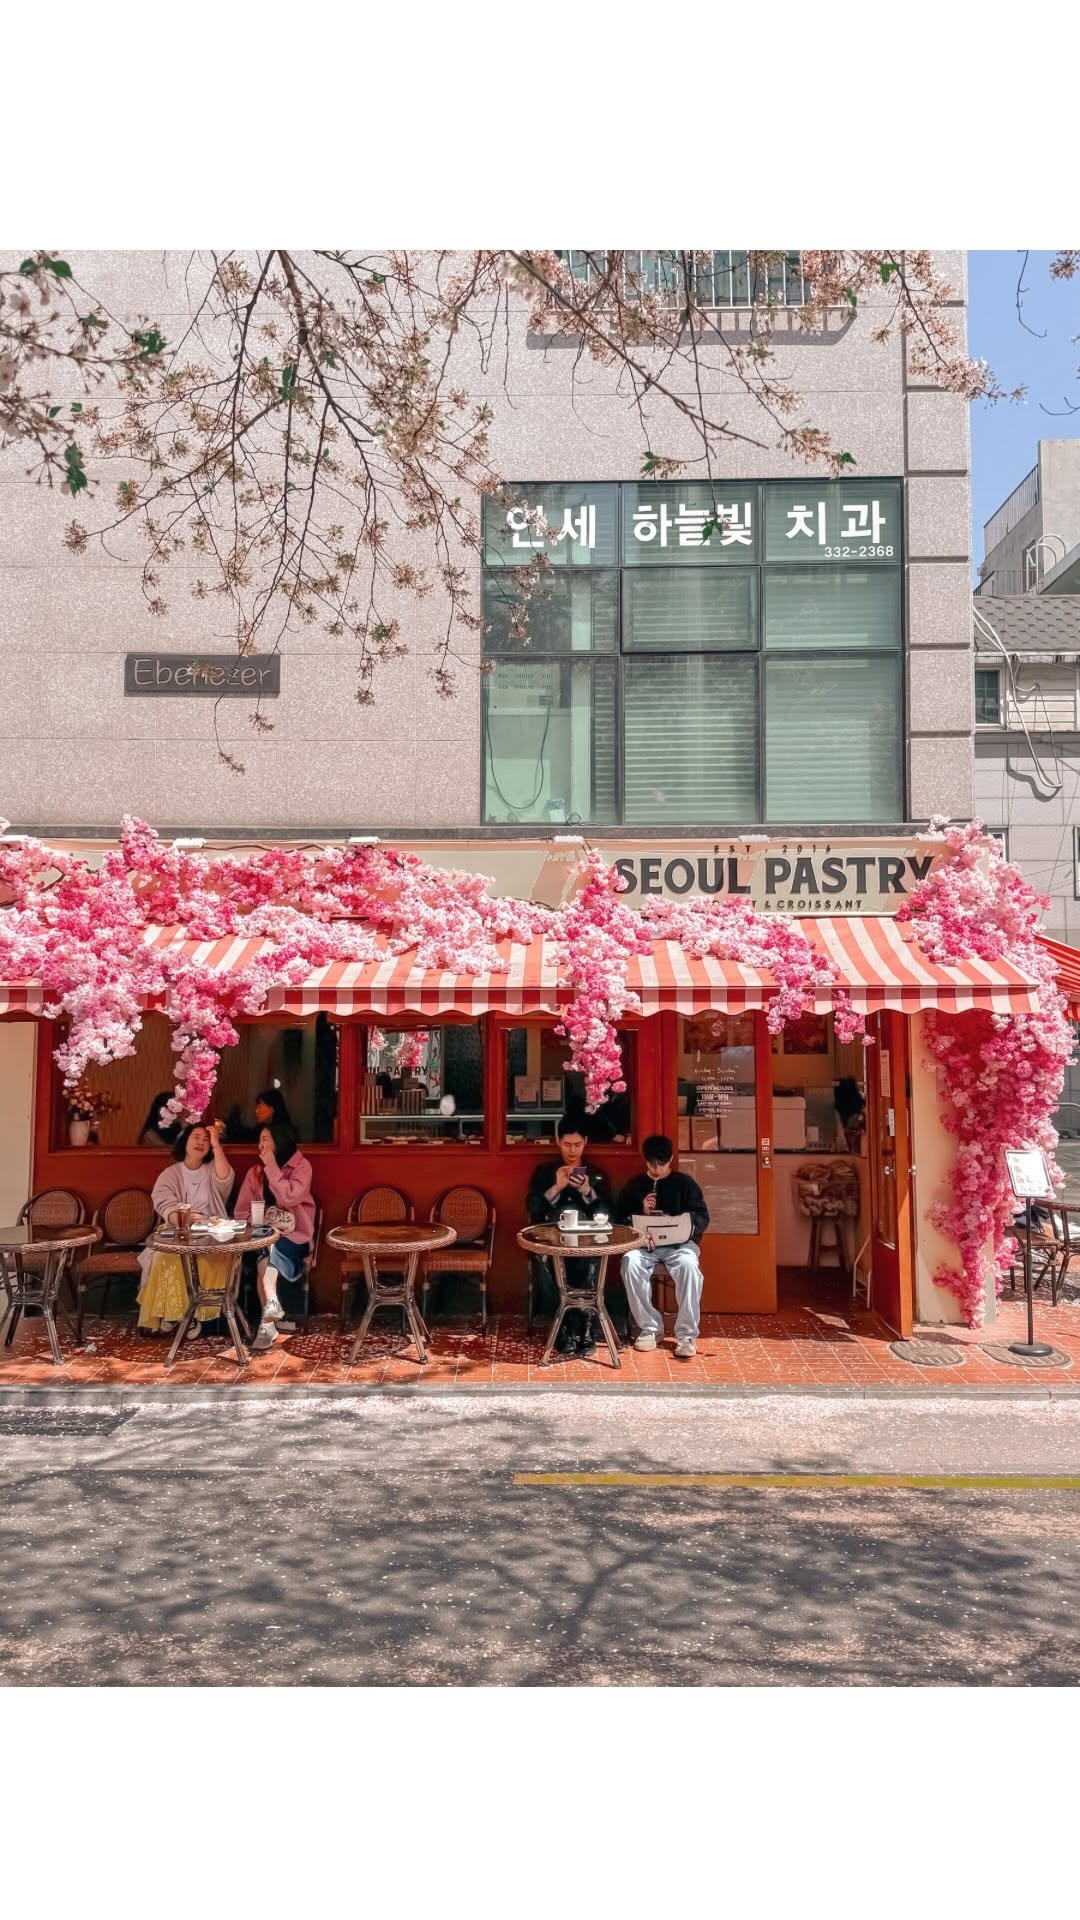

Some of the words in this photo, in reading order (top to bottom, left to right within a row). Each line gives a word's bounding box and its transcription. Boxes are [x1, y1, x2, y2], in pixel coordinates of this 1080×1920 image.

[632, 502, 753, 547] 하늘빛
[785, 500, 886, 545] 치과
[824, 546, 894, 557] 332-2368
[134, 659, 271, 686] Ebenezer
[782, 844, 832, 853] 2016
[614, 858, 751, 894] SEOUL
[764, 856, 936, 894] PASTRY
[777, 900, 863, 908] CROISSANT
